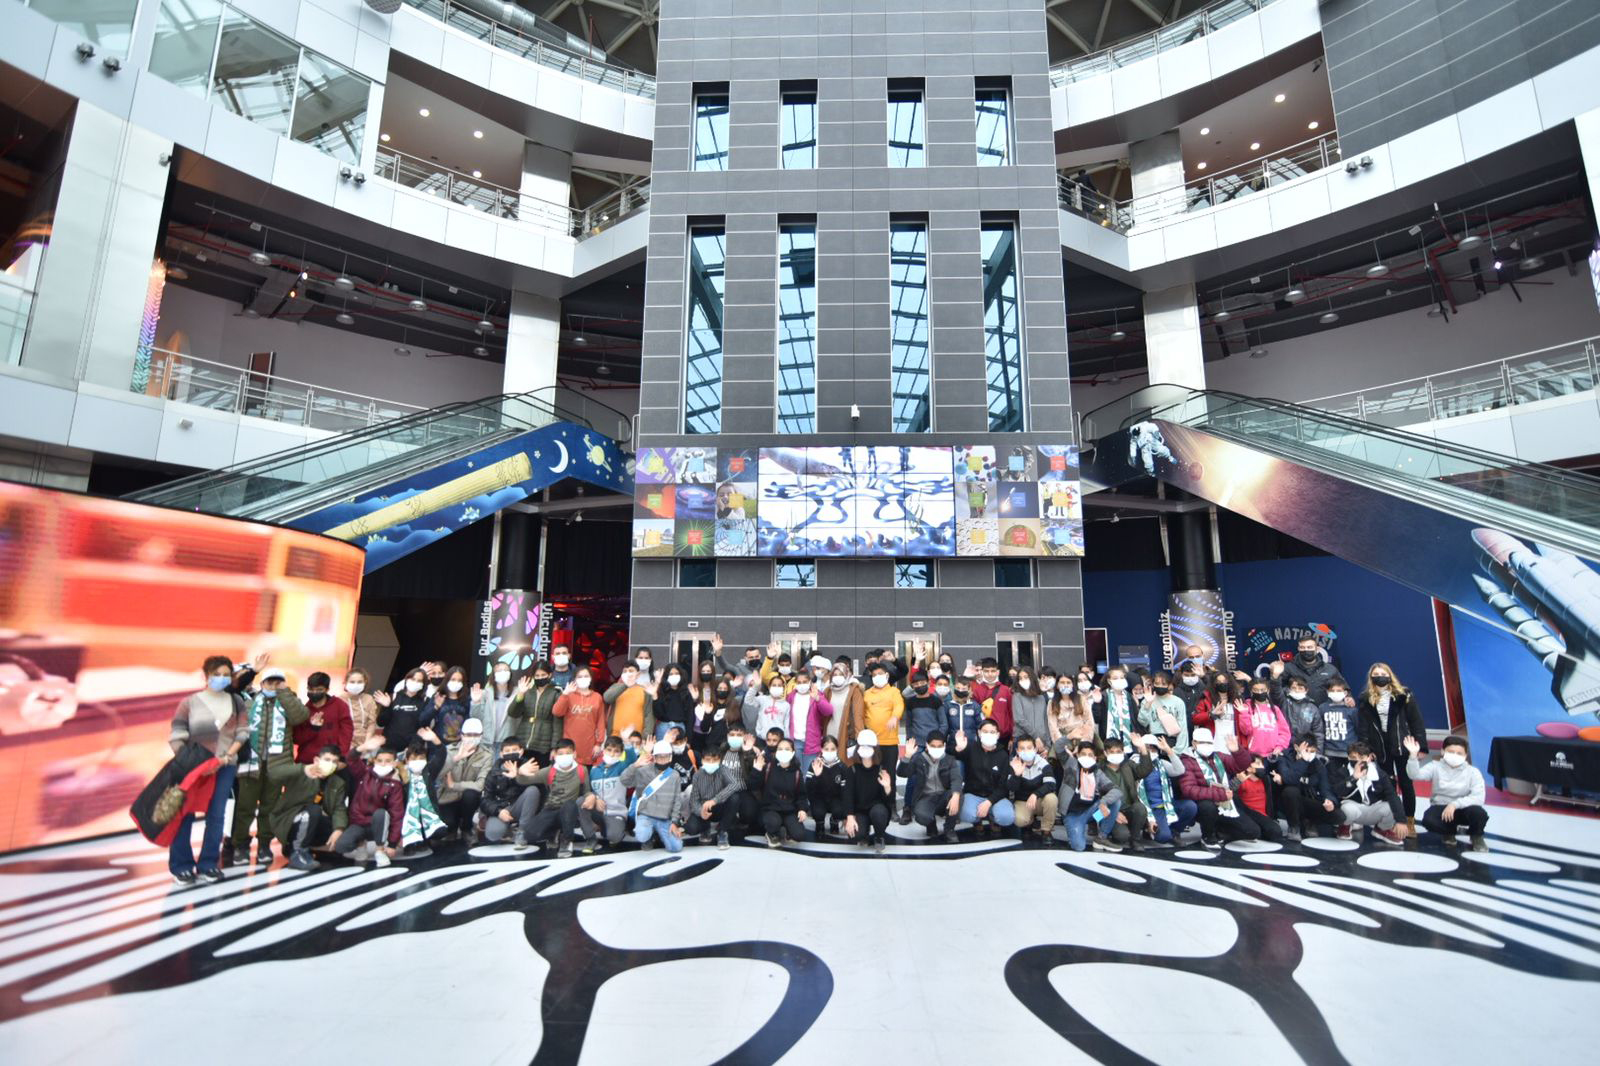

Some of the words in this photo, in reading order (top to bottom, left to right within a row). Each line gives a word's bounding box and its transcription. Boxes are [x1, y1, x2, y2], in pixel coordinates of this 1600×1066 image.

[480, 601, 492, 635] Bodies
[1224, 611, 1234, 632] Our
[479, 638, 490, 656] Our
[1159, 612, 1173, 670] Evrenimiz
[1226, 635, 1238, 671] Unive
